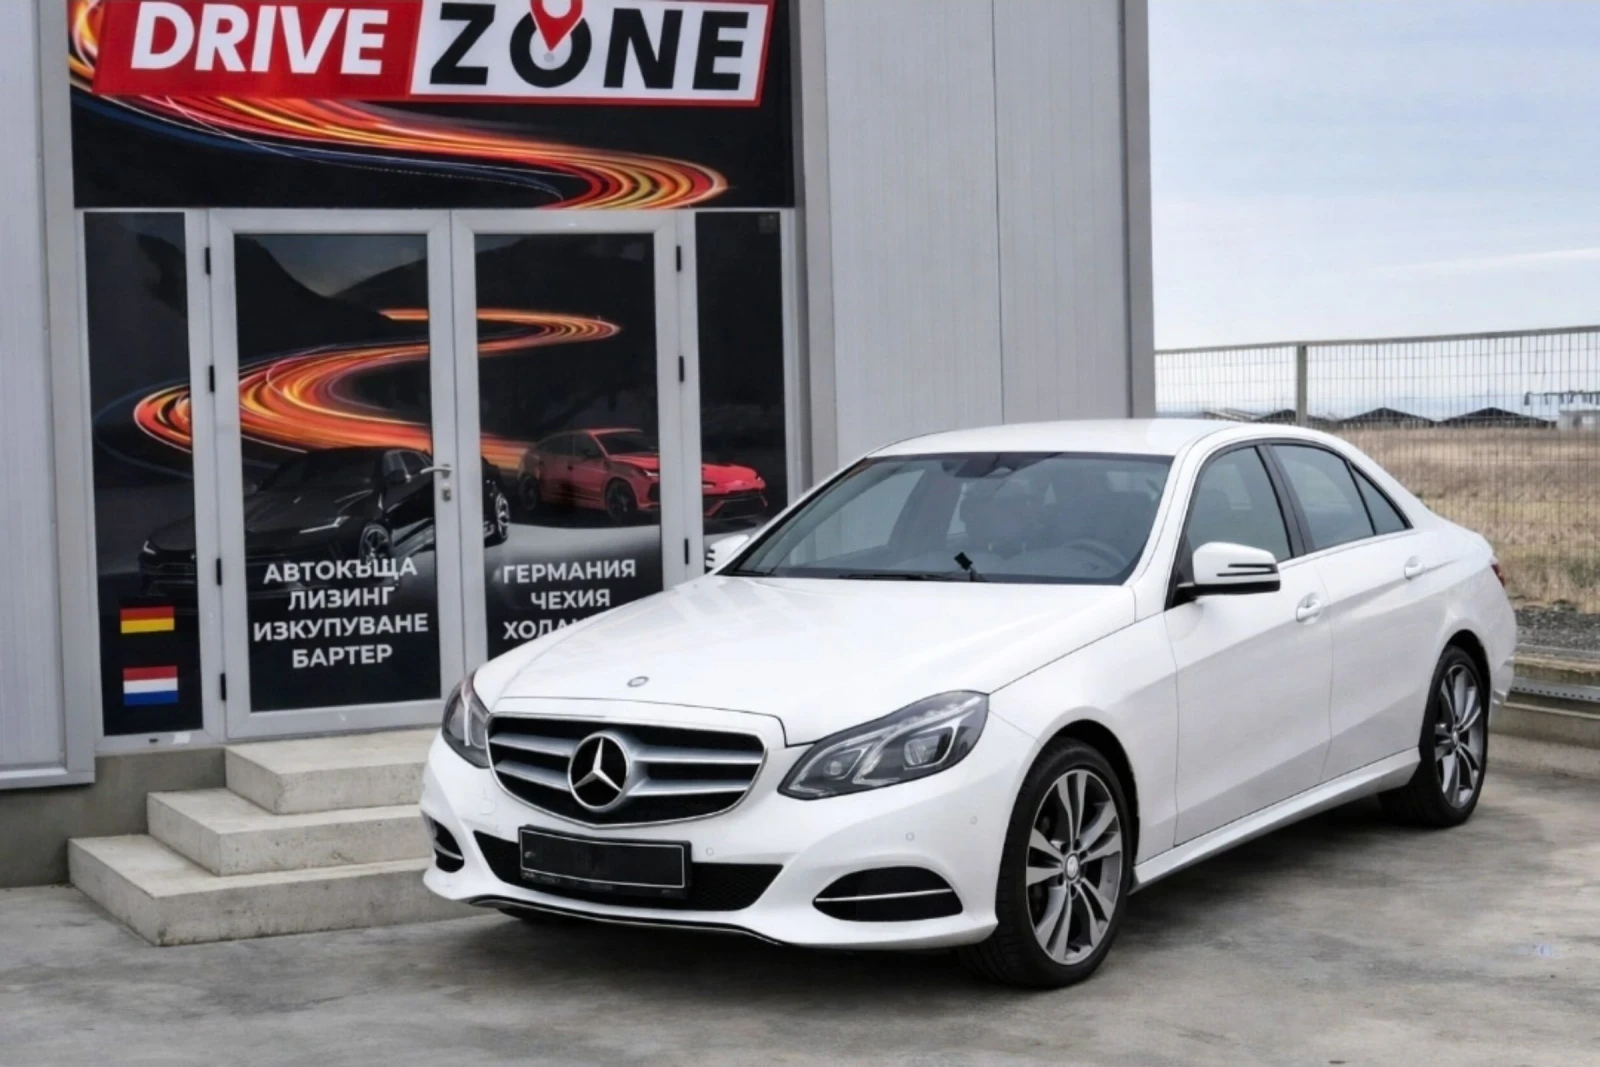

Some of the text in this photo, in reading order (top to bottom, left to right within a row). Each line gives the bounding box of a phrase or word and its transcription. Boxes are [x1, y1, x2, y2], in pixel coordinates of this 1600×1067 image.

[130, 1, 749, 91] DRIVE ZONE
[263, 556, 418, 585] АВТОКЪЩА
[503, 559, 636, 584] ГЕРМАНИЯ
[287, 586, 396, 611] ЛИЗИНГ
[530, 588, 611, 610] ЧЕХИЯ
[253, 613, 429, 642] ИЗКУПУВАНЕ
[292, 644, 393, 669] БАРТЕР
